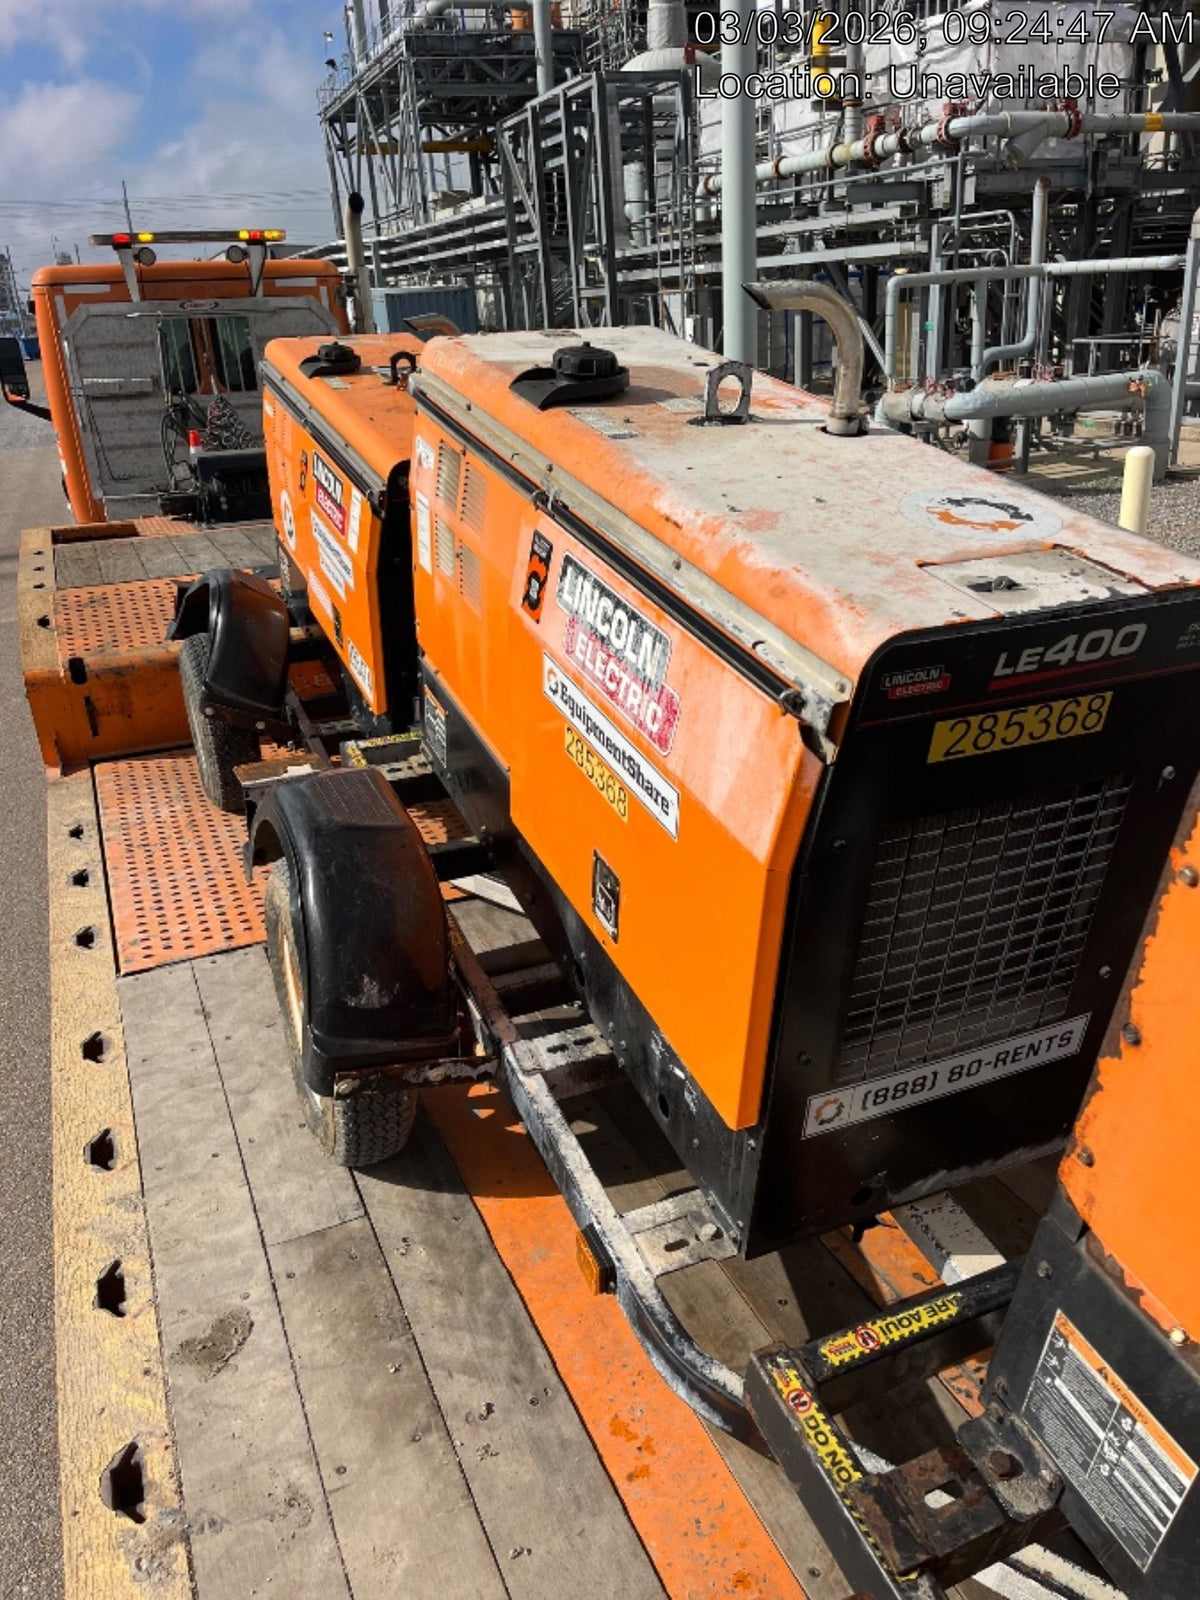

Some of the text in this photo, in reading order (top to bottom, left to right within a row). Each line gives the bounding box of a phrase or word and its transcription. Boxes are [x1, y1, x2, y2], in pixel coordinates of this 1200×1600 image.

[563, 564, 662, 682] LINCOLN
[993, 623, 1147, 677] LE400
[575, 630, 662, 734] ELECTRIC
[884, 668, 940, 687] LINCOLN
[895, 680, 944, 697] ELECTRIC
[558, 678, 671, 816] EquipmentShare
[943, 695, 1107, 758] 285368
[565, 727, 628, 819] 285368
[861, 1029, 1074, 1112] (888) 80-RENTS
[880, 1312, 922, 1340] AQUI
[803, 1414, 854, 1485] DO NO
